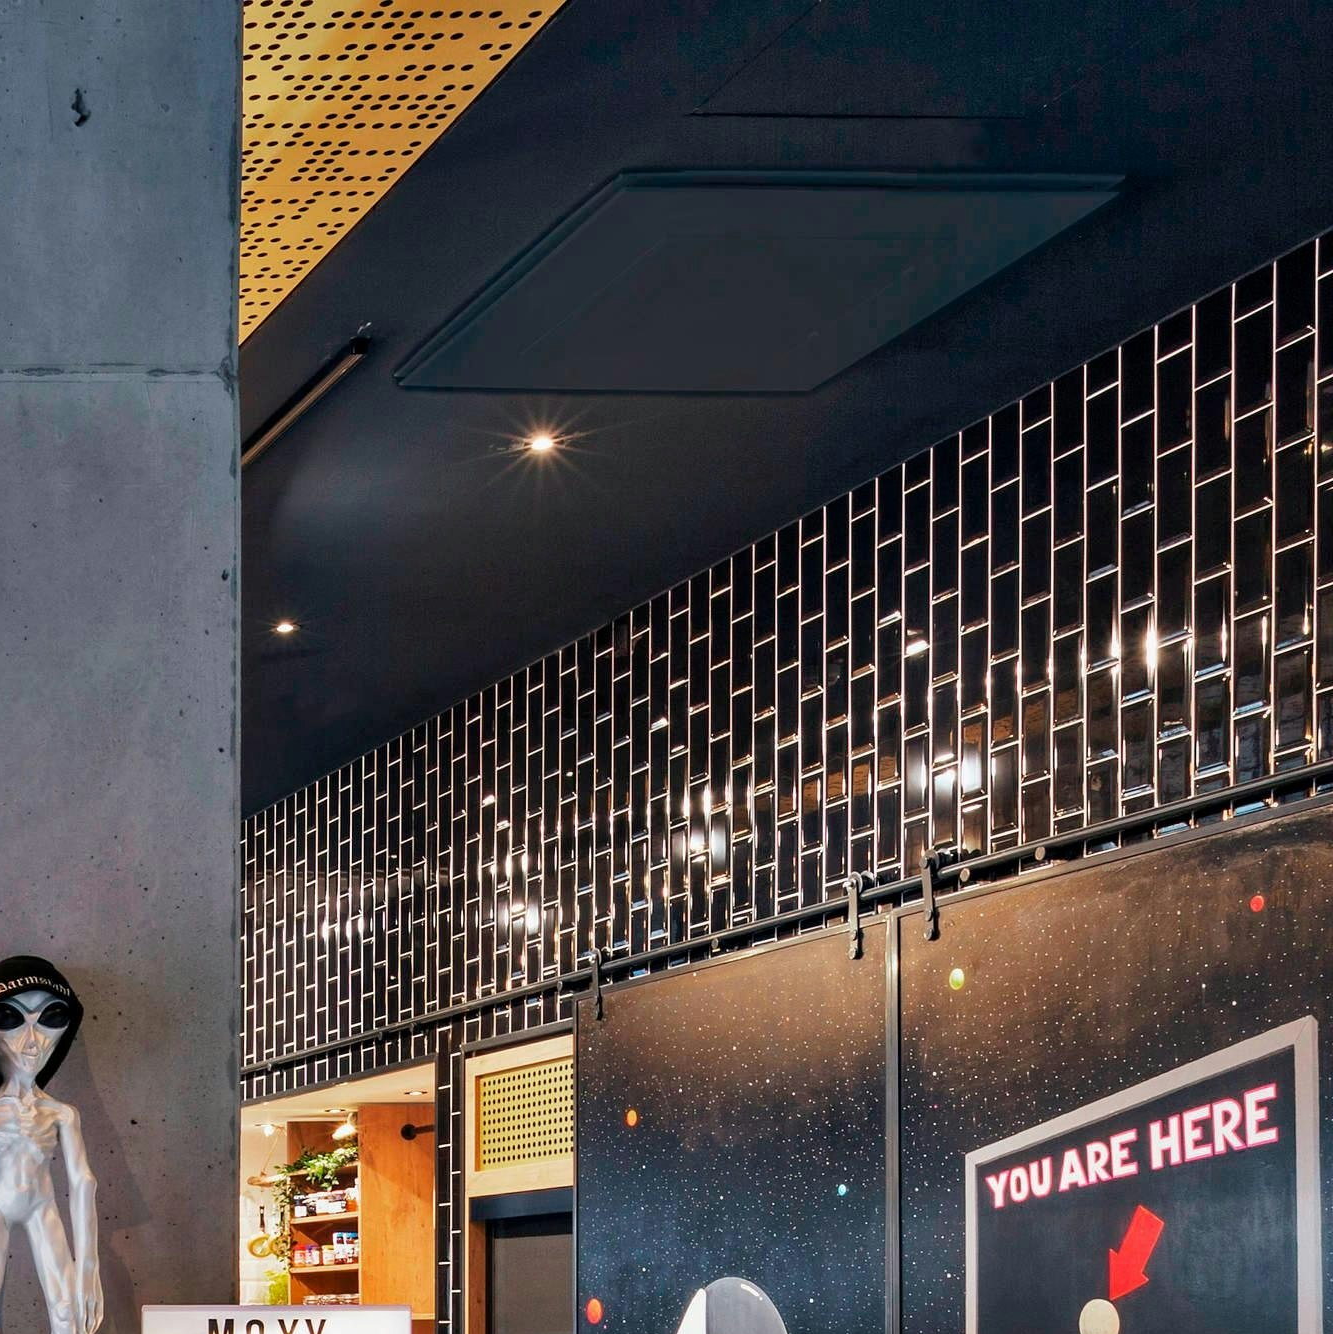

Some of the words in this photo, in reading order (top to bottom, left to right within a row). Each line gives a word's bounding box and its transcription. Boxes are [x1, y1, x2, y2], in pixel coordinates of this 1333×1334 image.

[985, 1155, 1053, 1208] YOU
[1058, 1129, 1139, 1192] ARE
[1148, 1083, 1279, 1170] HERE
